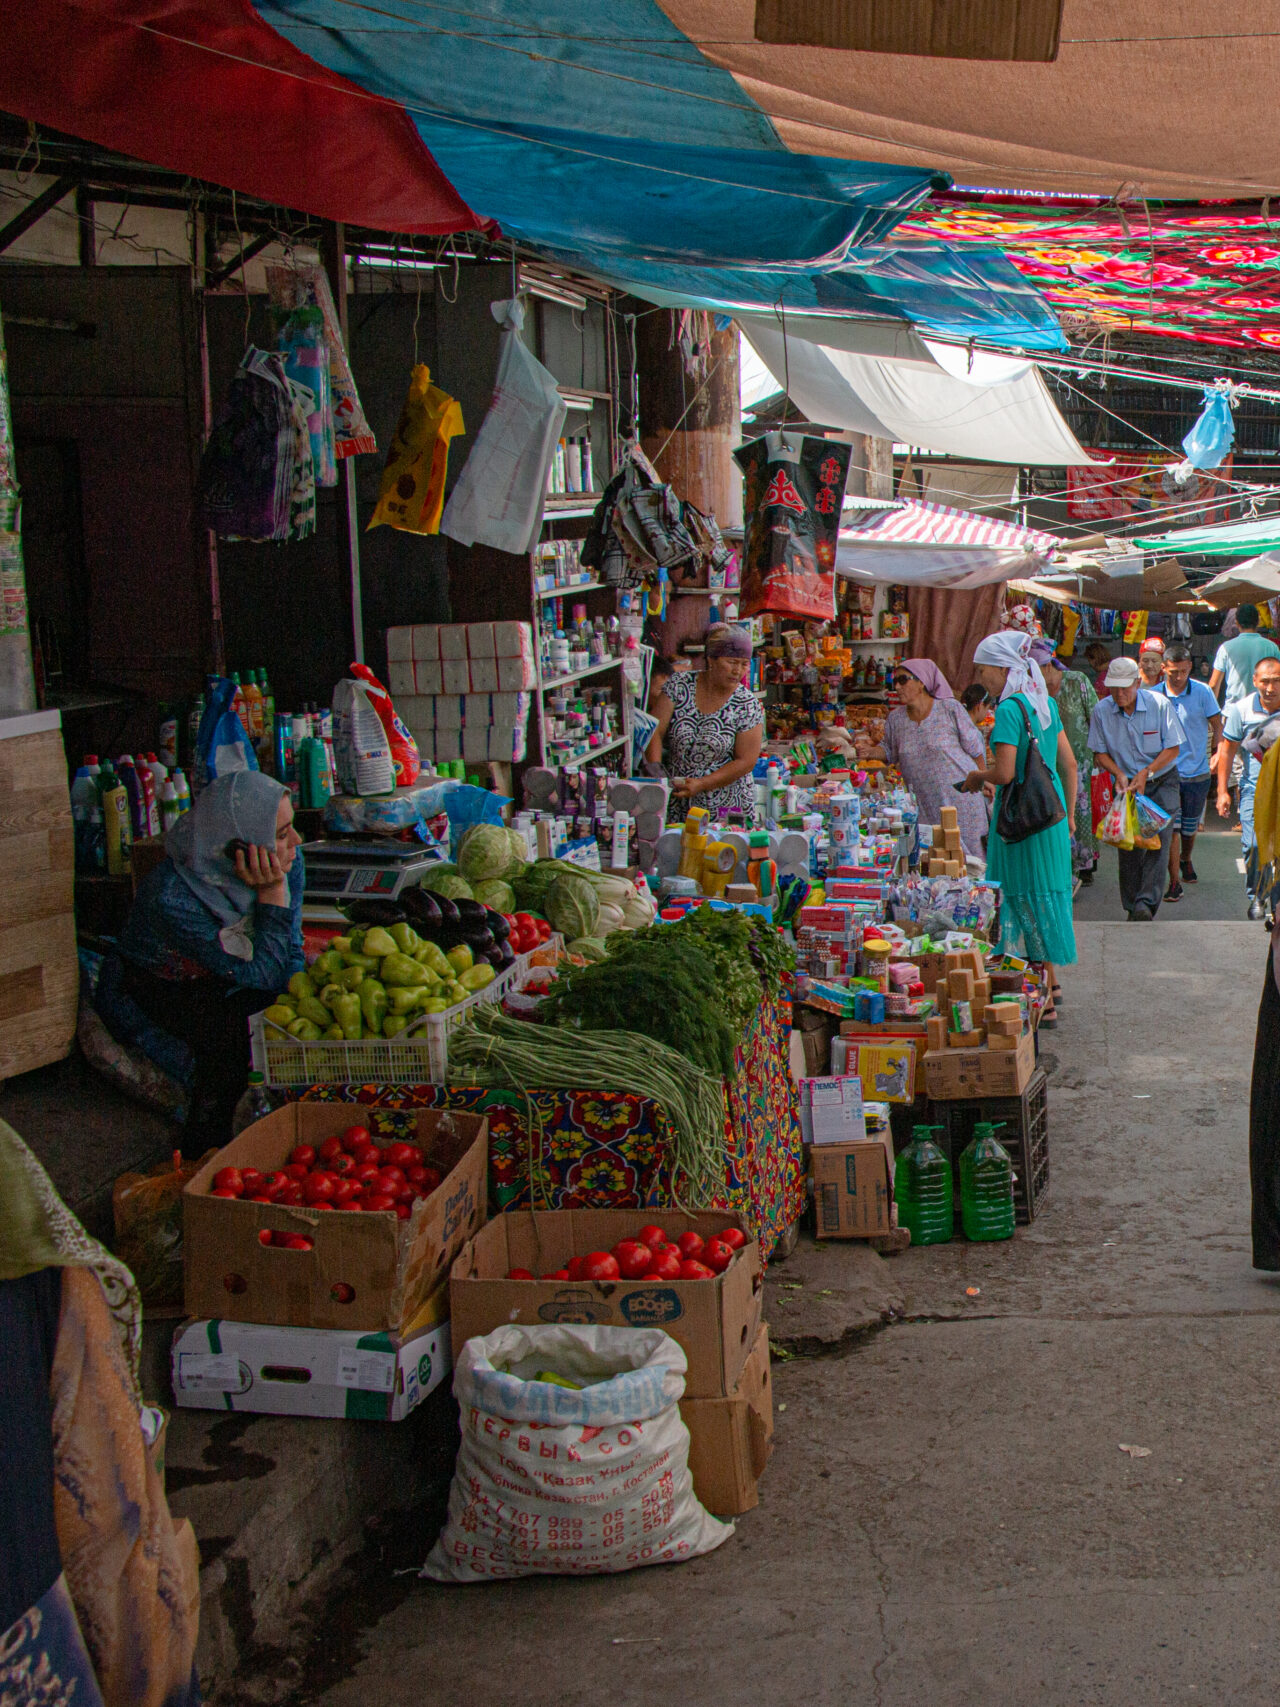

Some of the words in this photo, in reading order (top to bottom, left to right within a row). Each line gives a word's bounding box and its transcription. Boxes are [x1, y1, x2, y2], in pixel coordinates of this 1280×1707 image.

[469, 1407, 582, 1462] ПЕРВЫЙ
[535, 1487, 609, 1505] Казахстан,
[623, 1452, 671, 1492] Костанай
[509, 1506, 541, 1527] 707
[454, 1541, 505, 1562] ВЕС
